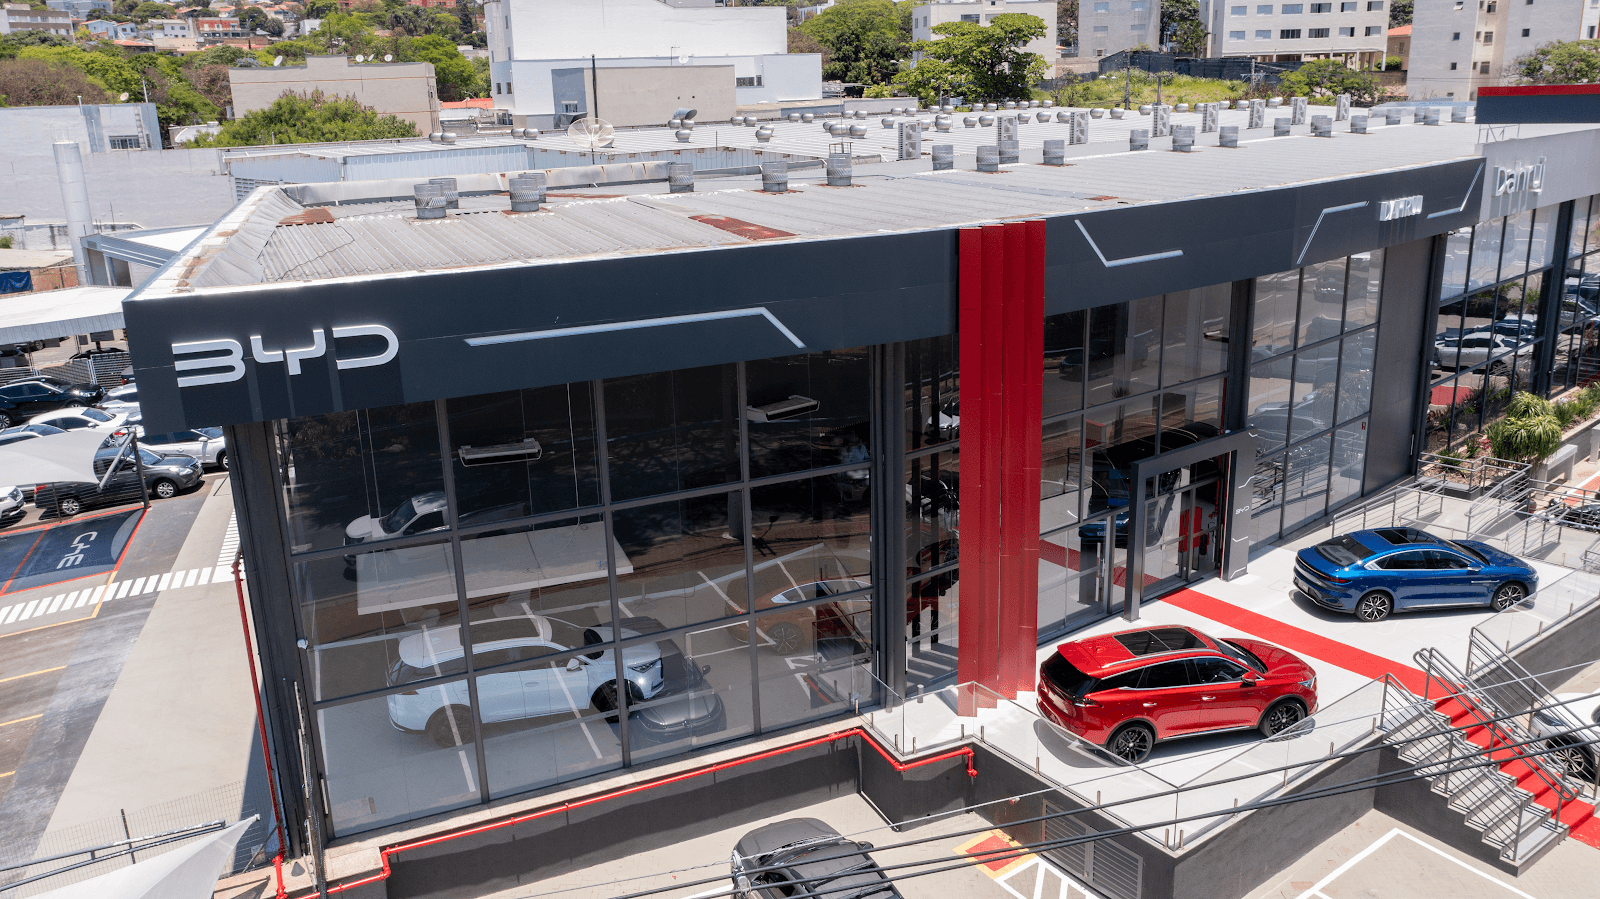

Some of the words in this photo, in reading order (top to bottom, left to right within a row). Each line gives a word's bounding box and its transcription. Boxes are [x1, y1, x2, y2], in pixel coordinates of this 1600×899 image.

[171, 324, 399, 388] BYD
[1235, 505, 1250, 515] BYD
[56, 531, 98, 570] BYD
